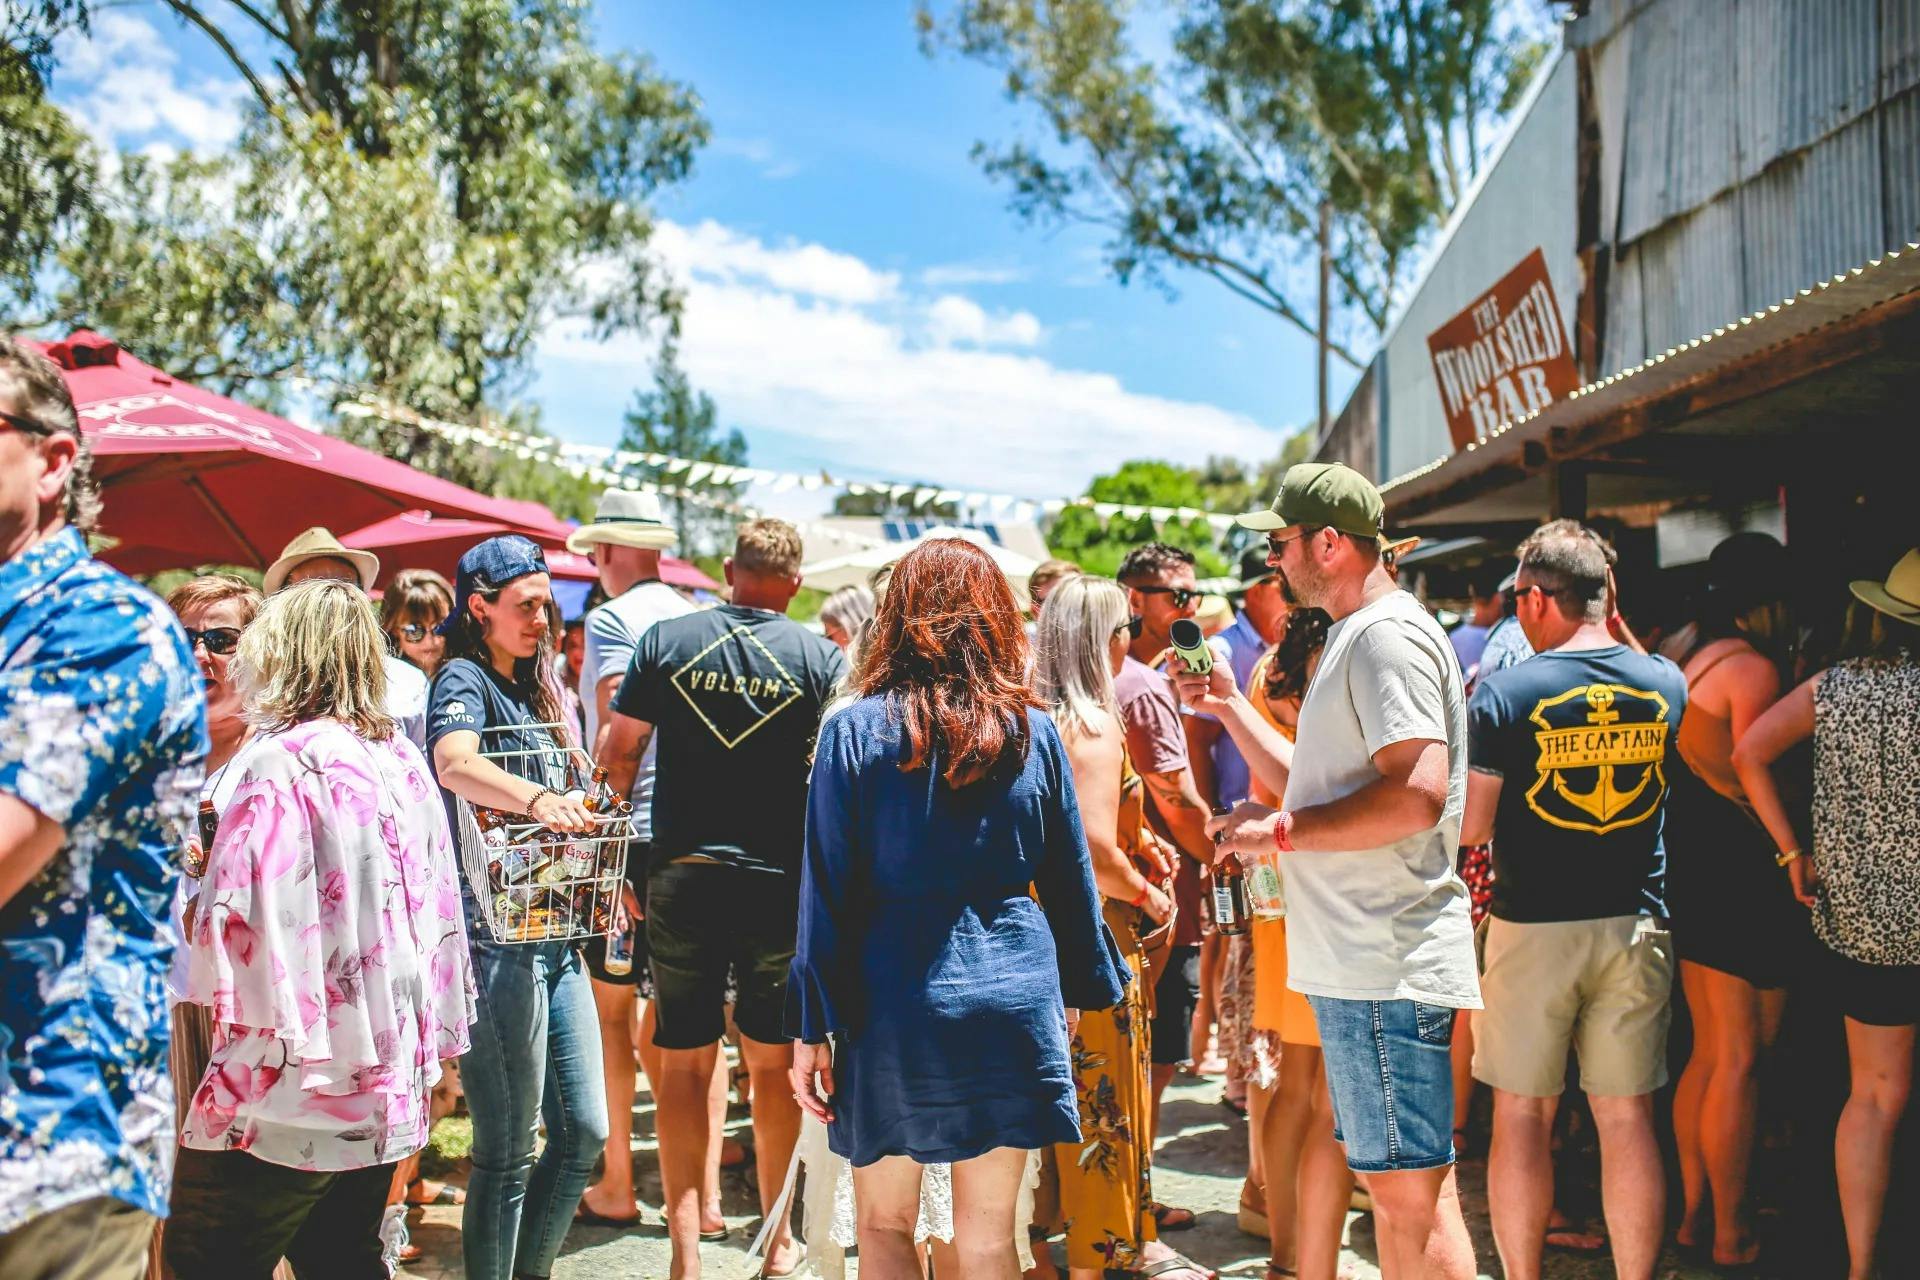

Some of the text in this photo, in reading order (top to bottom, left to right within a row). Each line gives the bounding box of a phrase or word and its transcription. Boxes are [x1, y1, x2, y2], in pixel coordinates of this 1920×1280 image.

[1472, 295, 1500, 336] THE
[1434, 280, 1562, 418] WOOLSHED
[1468, 366, 1553, 441] BAR
[690, 670, 783, 699] VOLCOM
[440, 713, 475, 726] VIVID
[1543, 729, 1661, 755] THE CAPTAIN
[1547, 755, 1570, 763] THE
[1583, 752, 1609, 761] MAD
